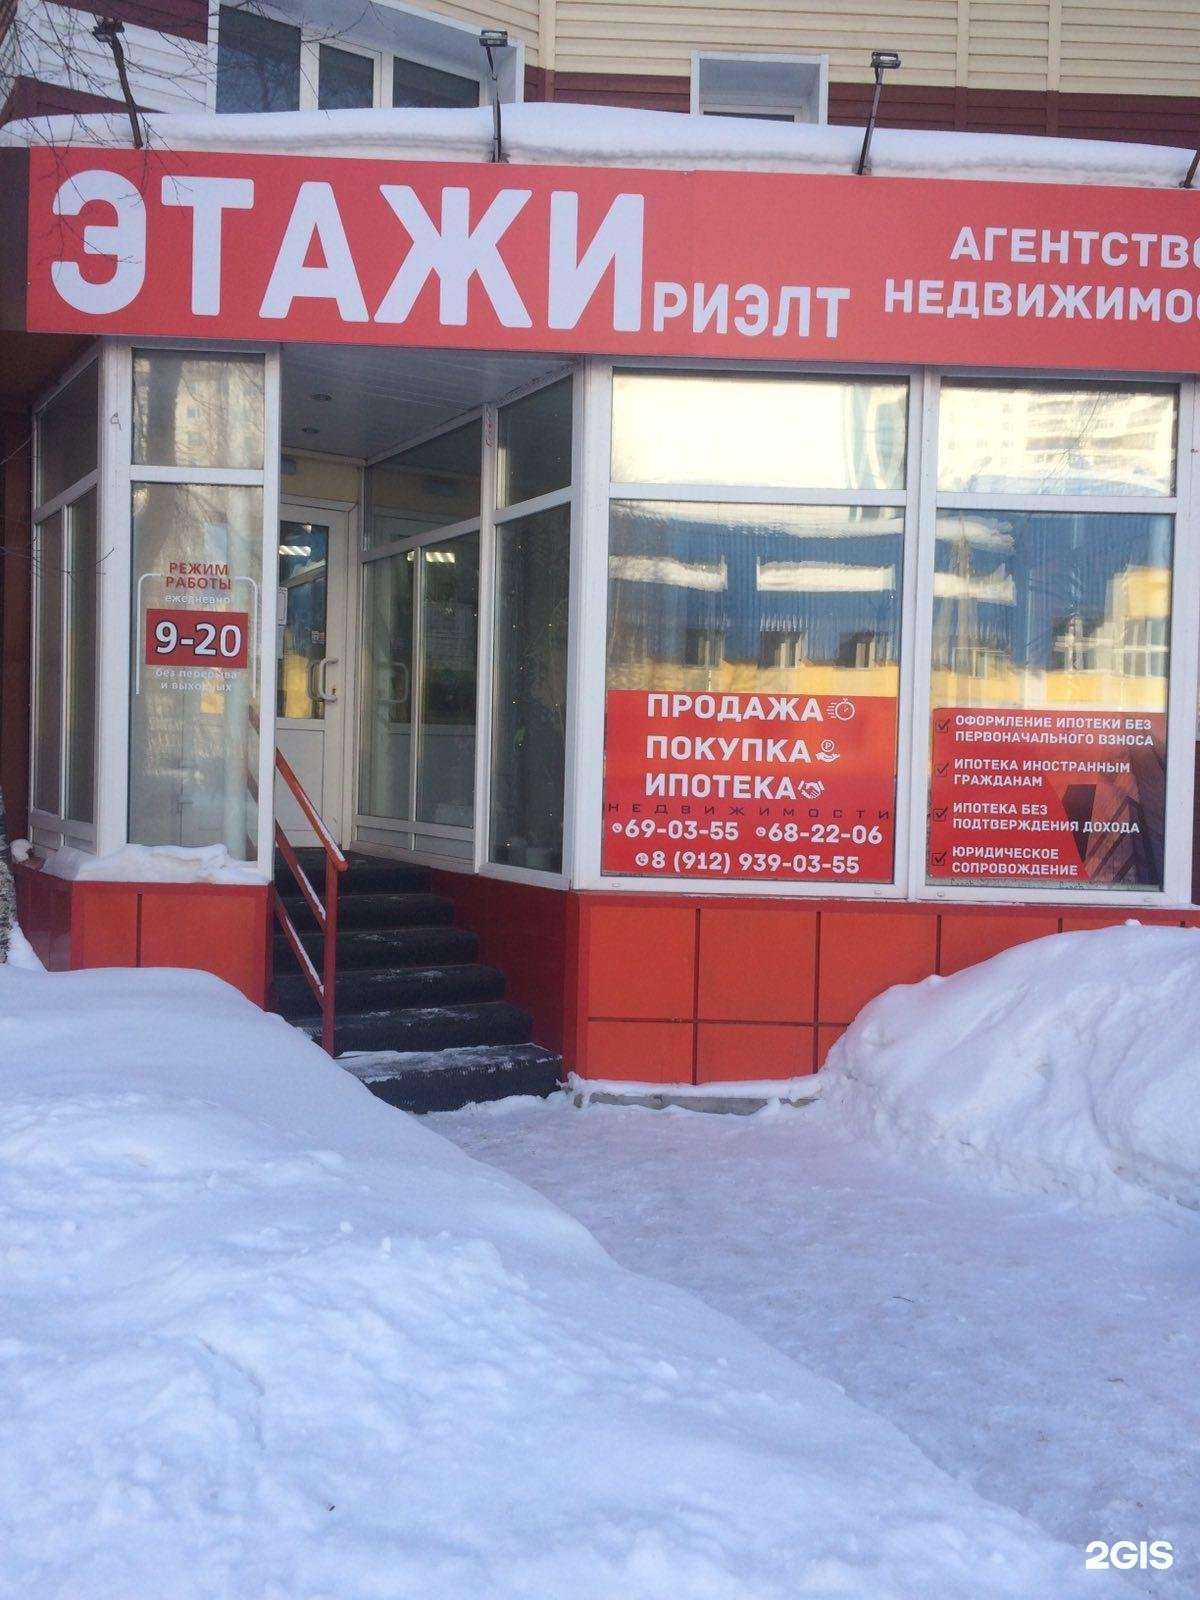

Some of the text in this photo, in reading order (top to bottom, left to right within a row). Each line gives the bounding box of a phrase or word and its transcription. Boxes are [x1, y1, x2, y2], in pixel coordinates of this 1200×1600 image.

[51, 169, 851, 338] ЭТАЖИ РИЭЛТ
[950, 226, 1200, 269] АГЕНТСТВ
[884, 278, 1200, 323] НЕДВИЖИМО
[169, 562, 229, 576] РЕЖИМ
[165, 576, 231, 590] РАБОТЫ
[155, 621, 242, 658] 9-20
[647, 693, 824, 723] ПРОДАЖА
[955, 715, 1152, 730] ОФОРМЛЕНИЕ ИПОТЕКИ БЕЗ
[955, 731, 1154, 746] ПЕРВОНАЧАЛЬНОГО ВЗНОСА
[646, 735, 812, 763] ПОКУПКА
[954, 758, 1130, 773] ИПОТЕКА ИНОСТРАННЫМ
[645, 773, 797, 800] ИПОТЕКА
[954, 774, 1043, 788] ГРАЖДАНАМ
[608, 803, 890, 820] НЕДВИЖИМОСТИ
[953, 803, 1048, 816] ИПОТЕКА БЕЗ
[625, 819, 883, 845] 69-03-55 68-22-06
[953, 818, 1140, 834] ПОДТВЕРЖДЕНИЯ ДОХОДА
[952, 846, 1059, 860] ЮРИДИЧЕСКОЕ
[652, 850, 860, 874] 8 (912) 939-03-55
[952, 862, 1078, 876] СОПРОВОЖДЕНИЕ
